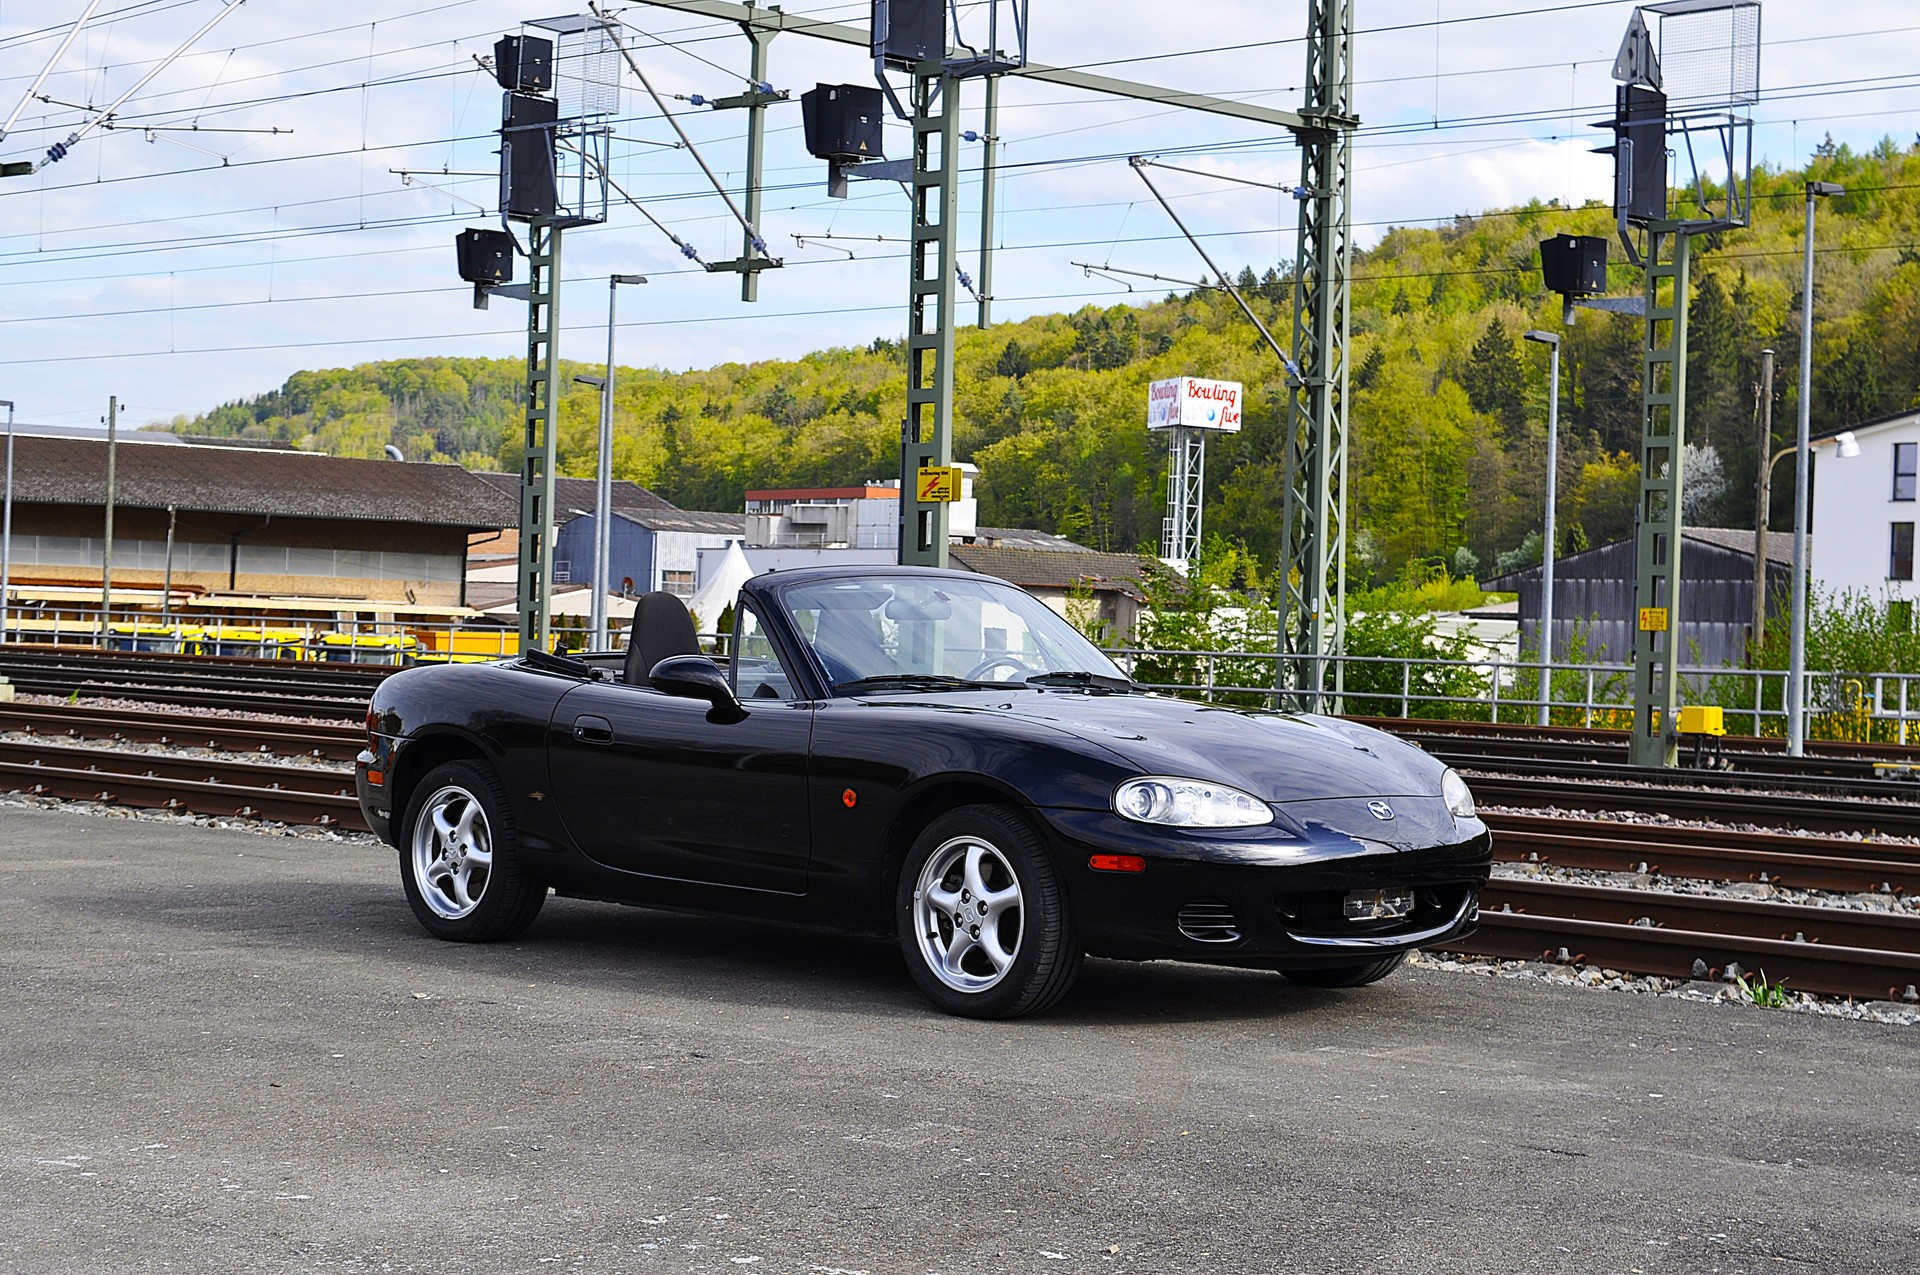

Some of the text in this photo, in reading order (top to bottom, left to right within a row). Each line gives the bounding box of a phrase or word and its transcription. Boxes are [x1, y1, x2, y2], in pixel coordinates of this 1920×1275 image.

[1151, 381, 1178, 403] Bowling
[1187, 380, 1236, 407] Bowling
[1219, 406, 1239, 427] five
